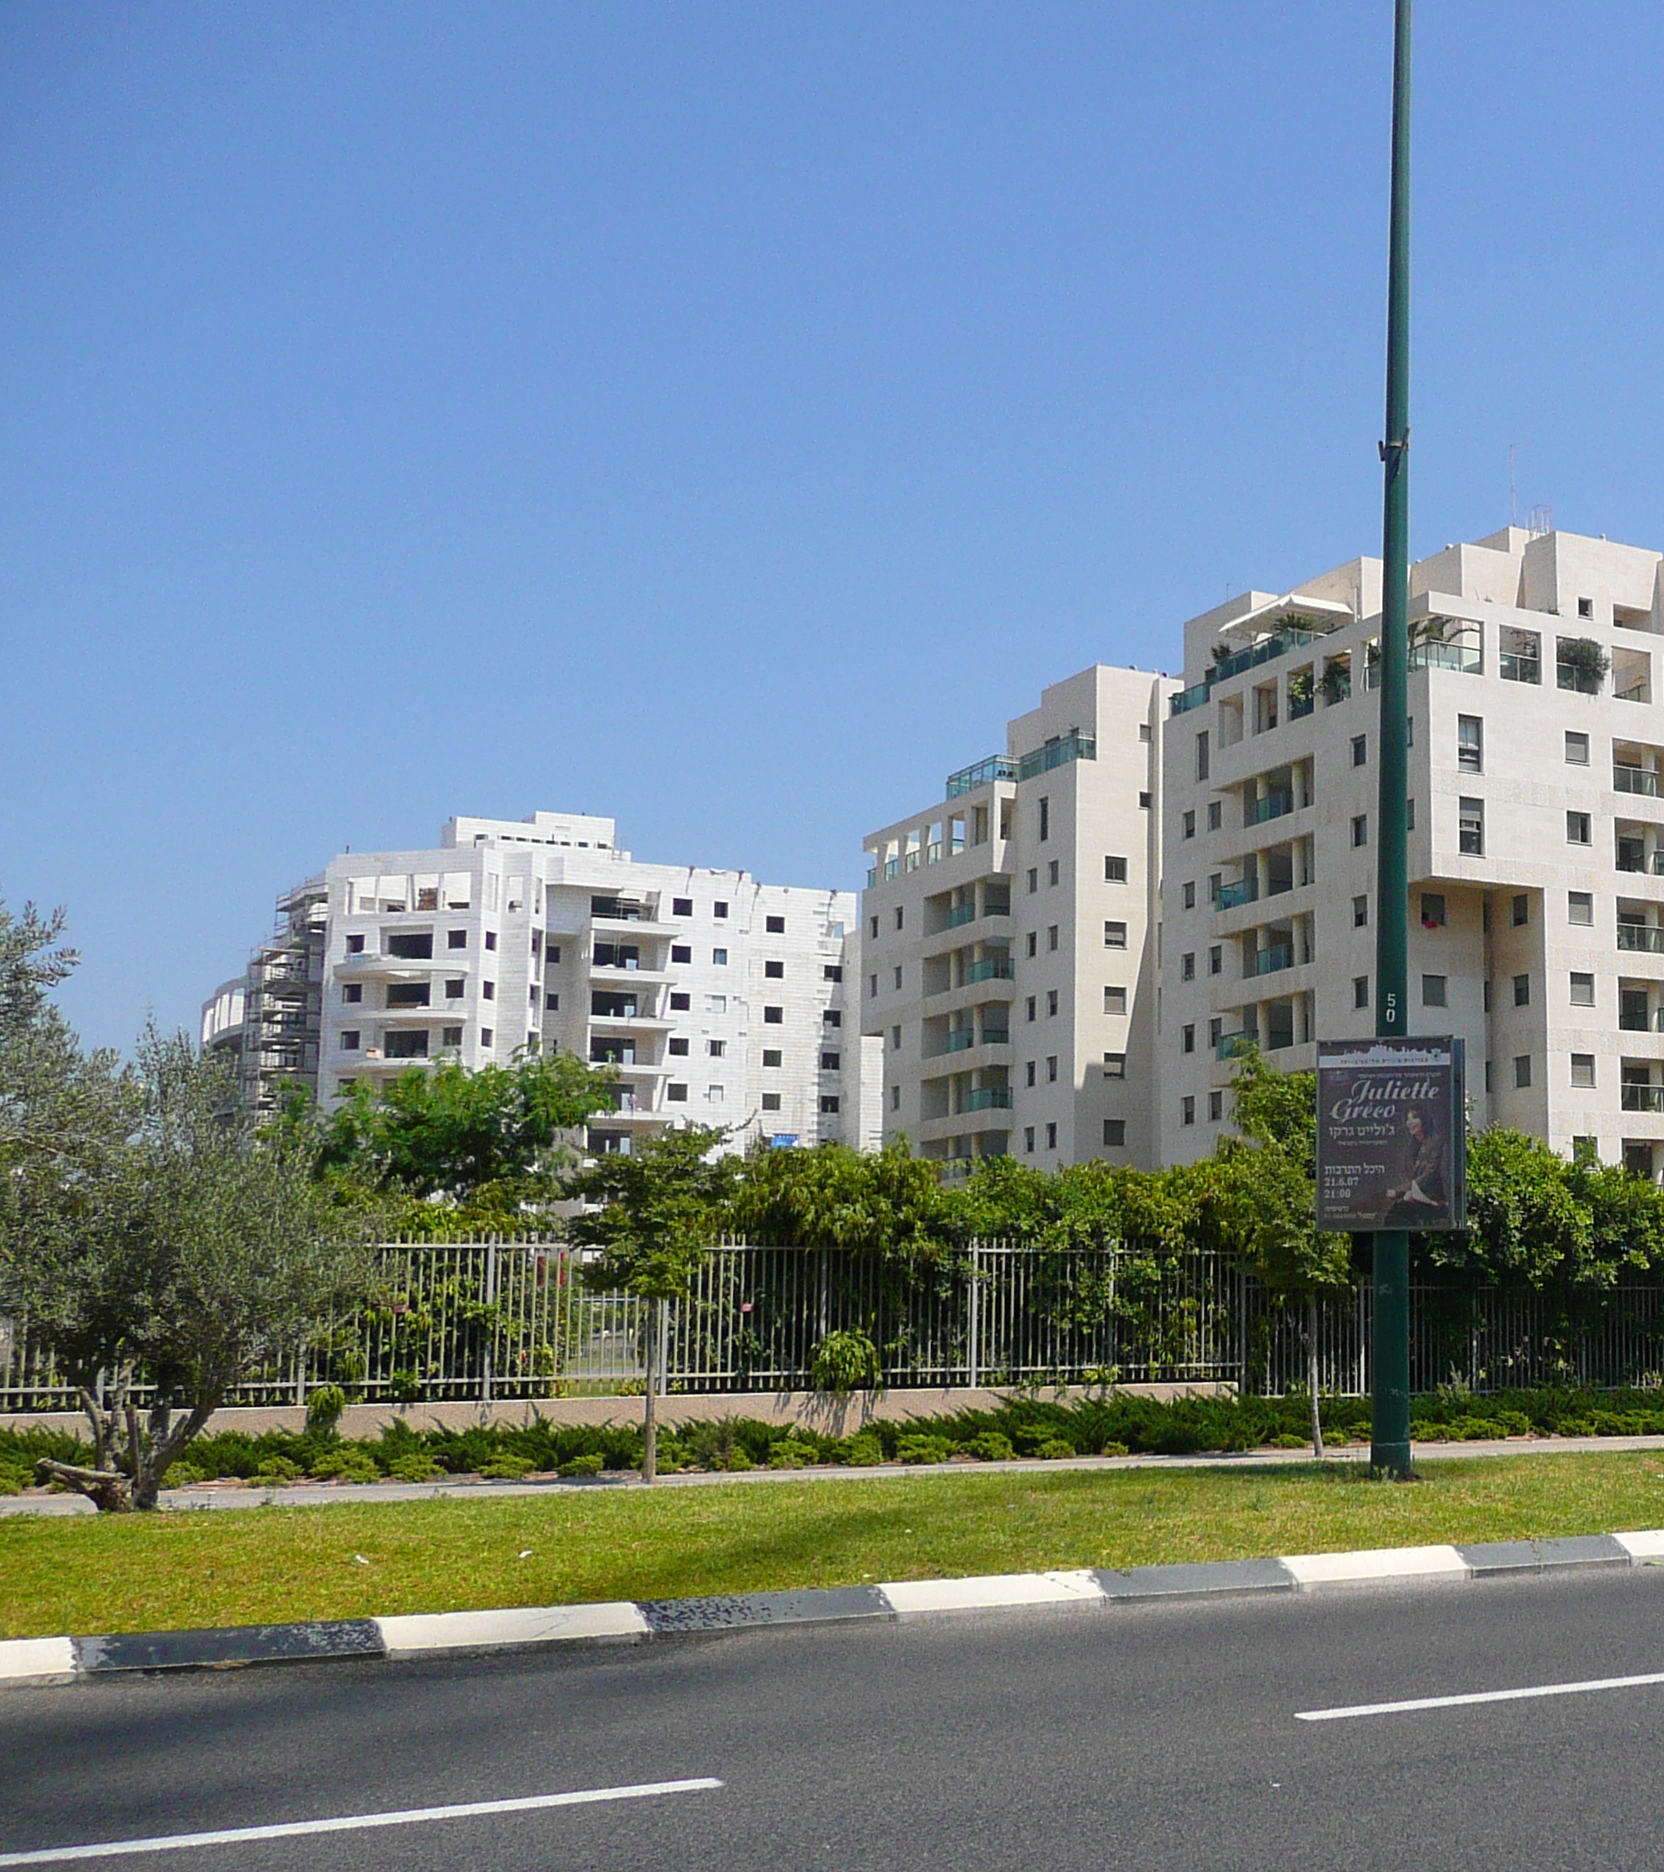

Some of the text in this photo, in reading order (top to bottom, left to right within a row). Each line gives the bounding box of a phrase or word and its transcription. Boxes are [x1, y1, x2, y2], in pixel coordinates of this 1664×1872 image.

[1351, 1080, 1440, 1104] Juliette
[1328, 1126, 1355, 1139] גרקו
[1324, 1162, 1385, 1175] היכל התרבות
[1324, 1177, 1359, 1187] 21.6.07
[1323, 1188, 1351, 1199] 21:00
